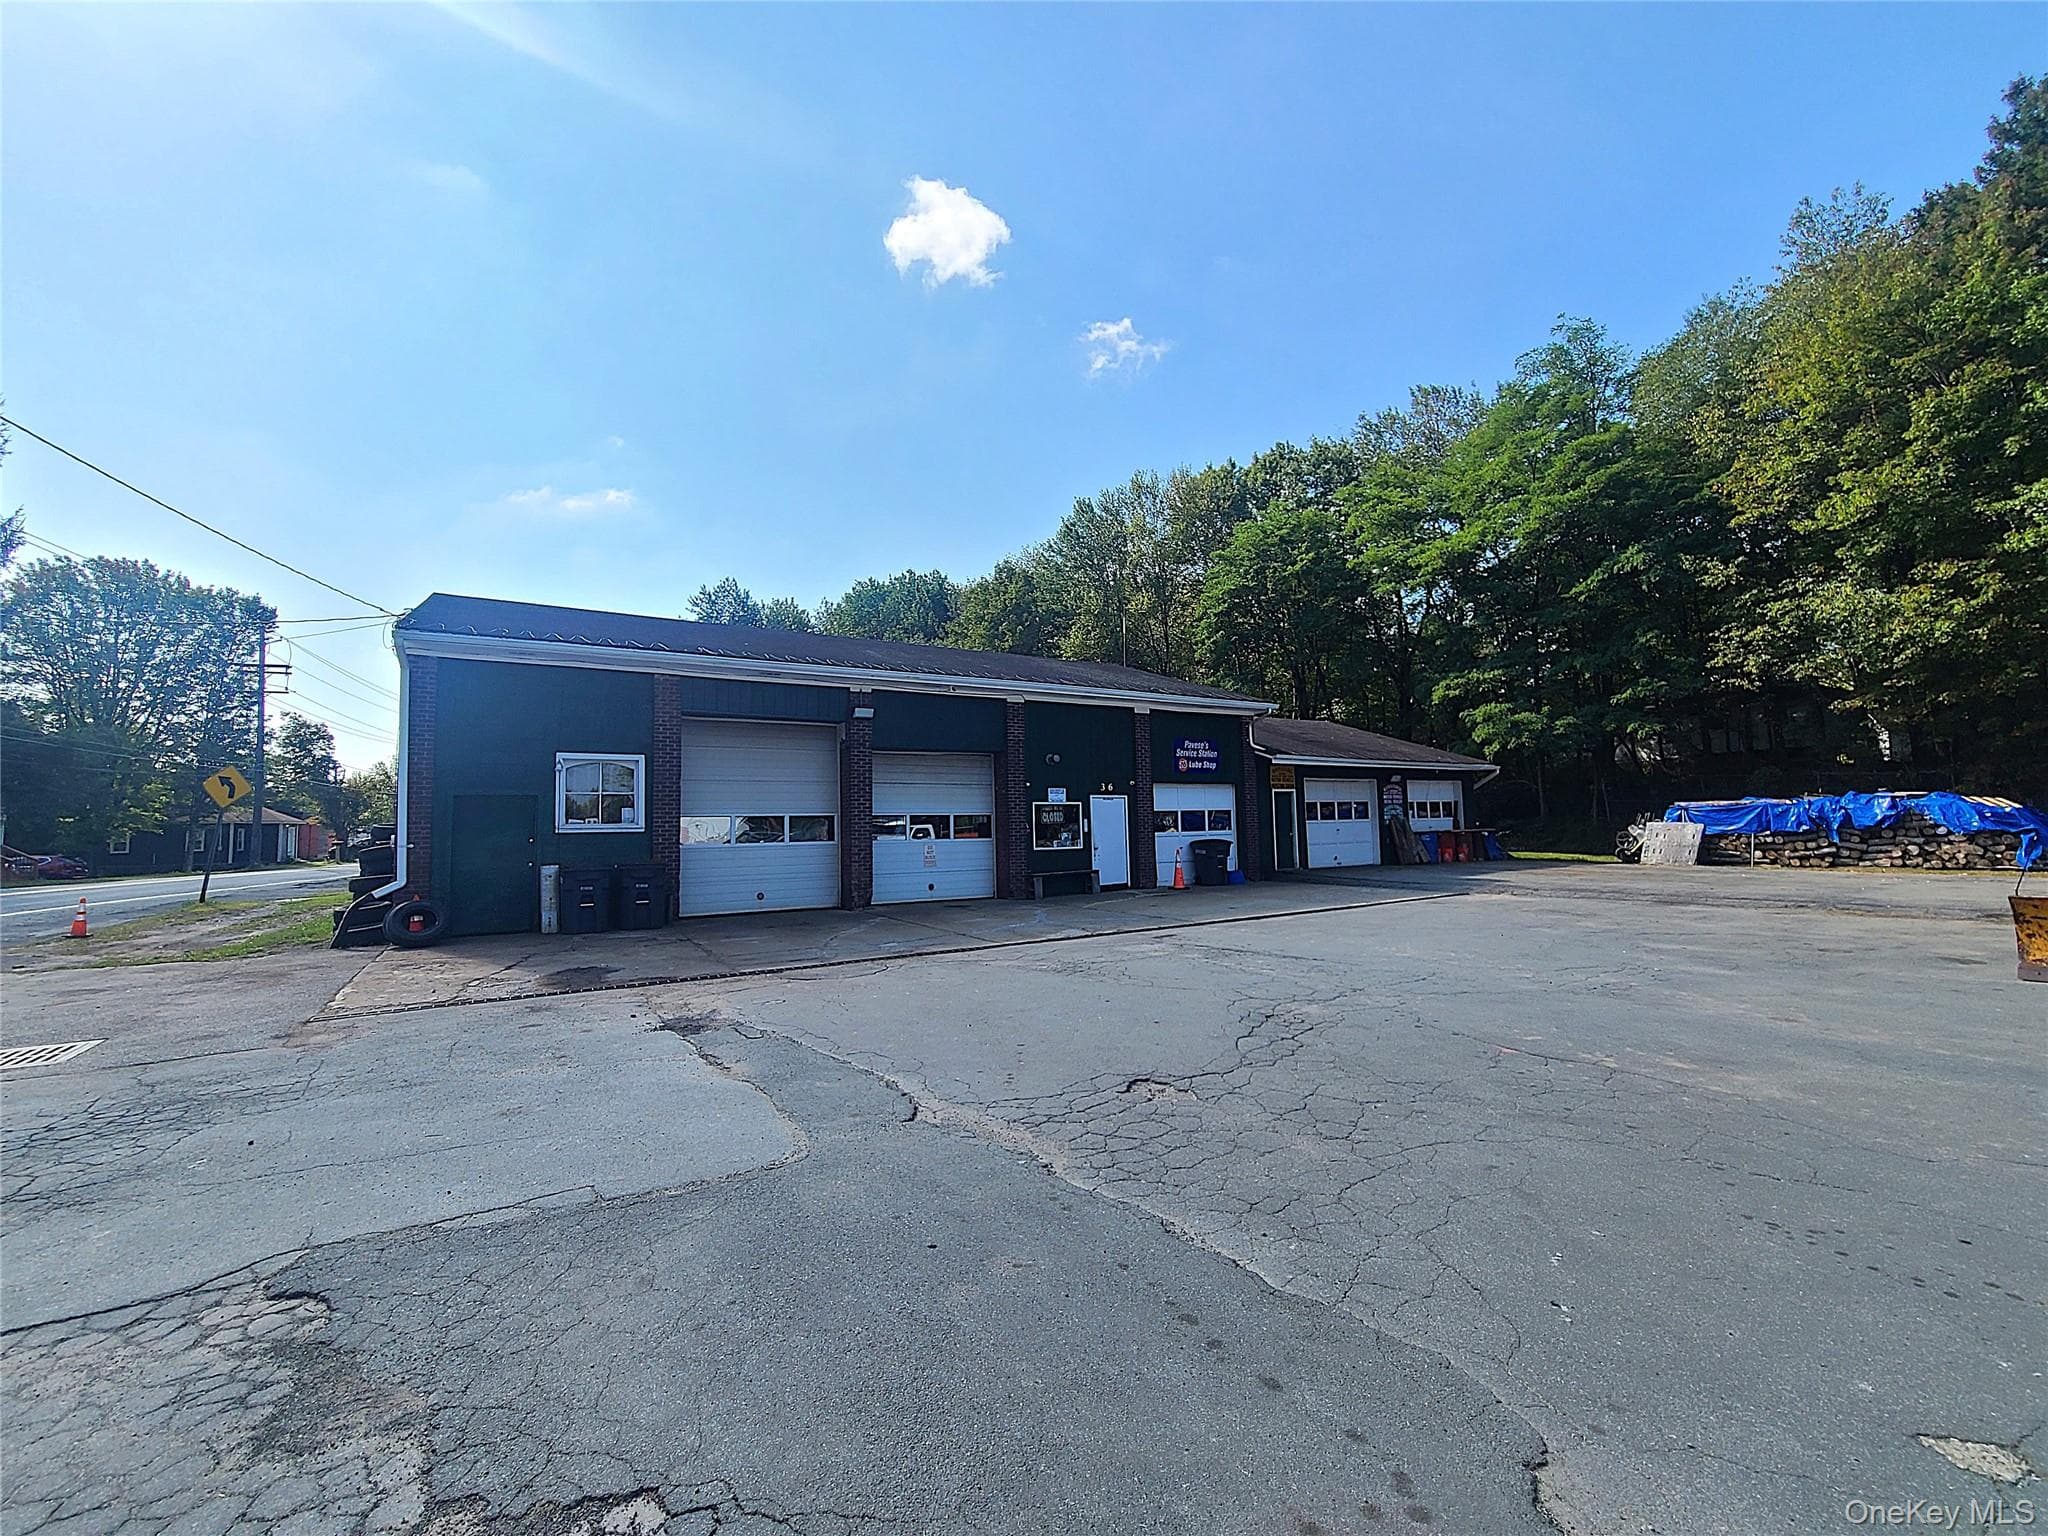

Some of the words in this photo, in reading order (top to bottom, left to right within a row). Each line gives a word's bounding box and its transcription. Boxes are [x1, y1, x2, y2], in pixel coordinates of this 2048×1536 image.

[1184, 740, 1209, 749] Pavese's
[1176, 748, 1198, 757] Service
[1198, 749, 1218, 758] Station
[1188, 760, 1202, 769] Lube
[1203, 761, 1217, 770] Shop
